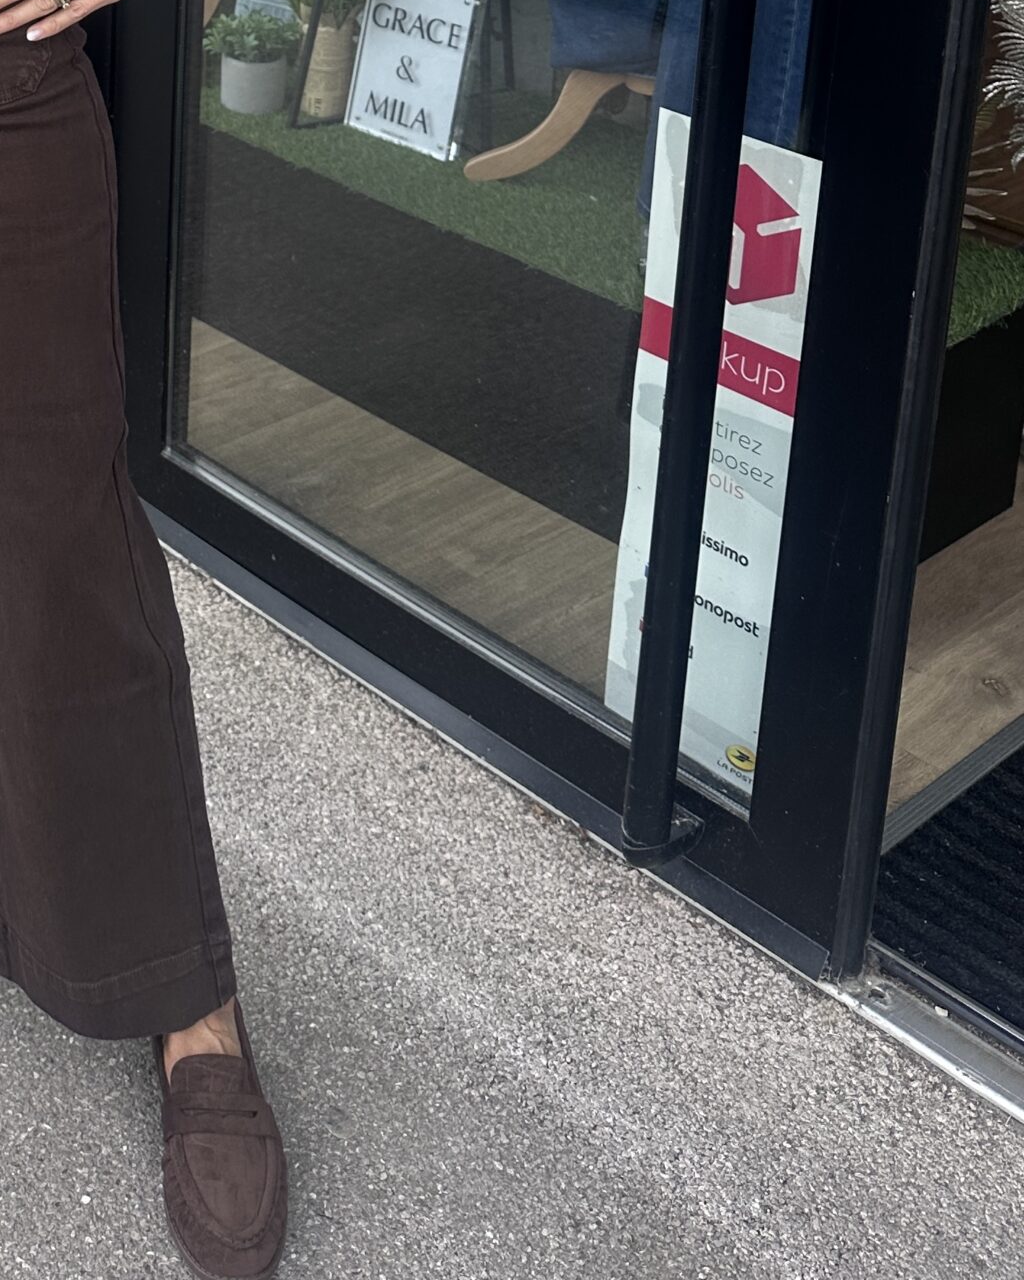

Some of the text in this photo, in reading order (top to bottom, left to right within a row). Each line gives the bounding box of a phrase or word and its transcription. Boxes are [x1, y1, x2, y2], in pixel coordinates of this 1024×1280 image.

[372, 3, 462, 49] GRACE
[396, 55, 414, 83] &
[365, 90, 428, 134] MILA
[721, 341, 785, 395] kup
[715, 420, 763, 456] tirez
[709, 473, 744, 500] olis
[711, 447, 774, 488] posez
[701, 531, 749, 567] issimo
[694, 594, 760, 638] onopost
[730, 767, 752, 784] POST
